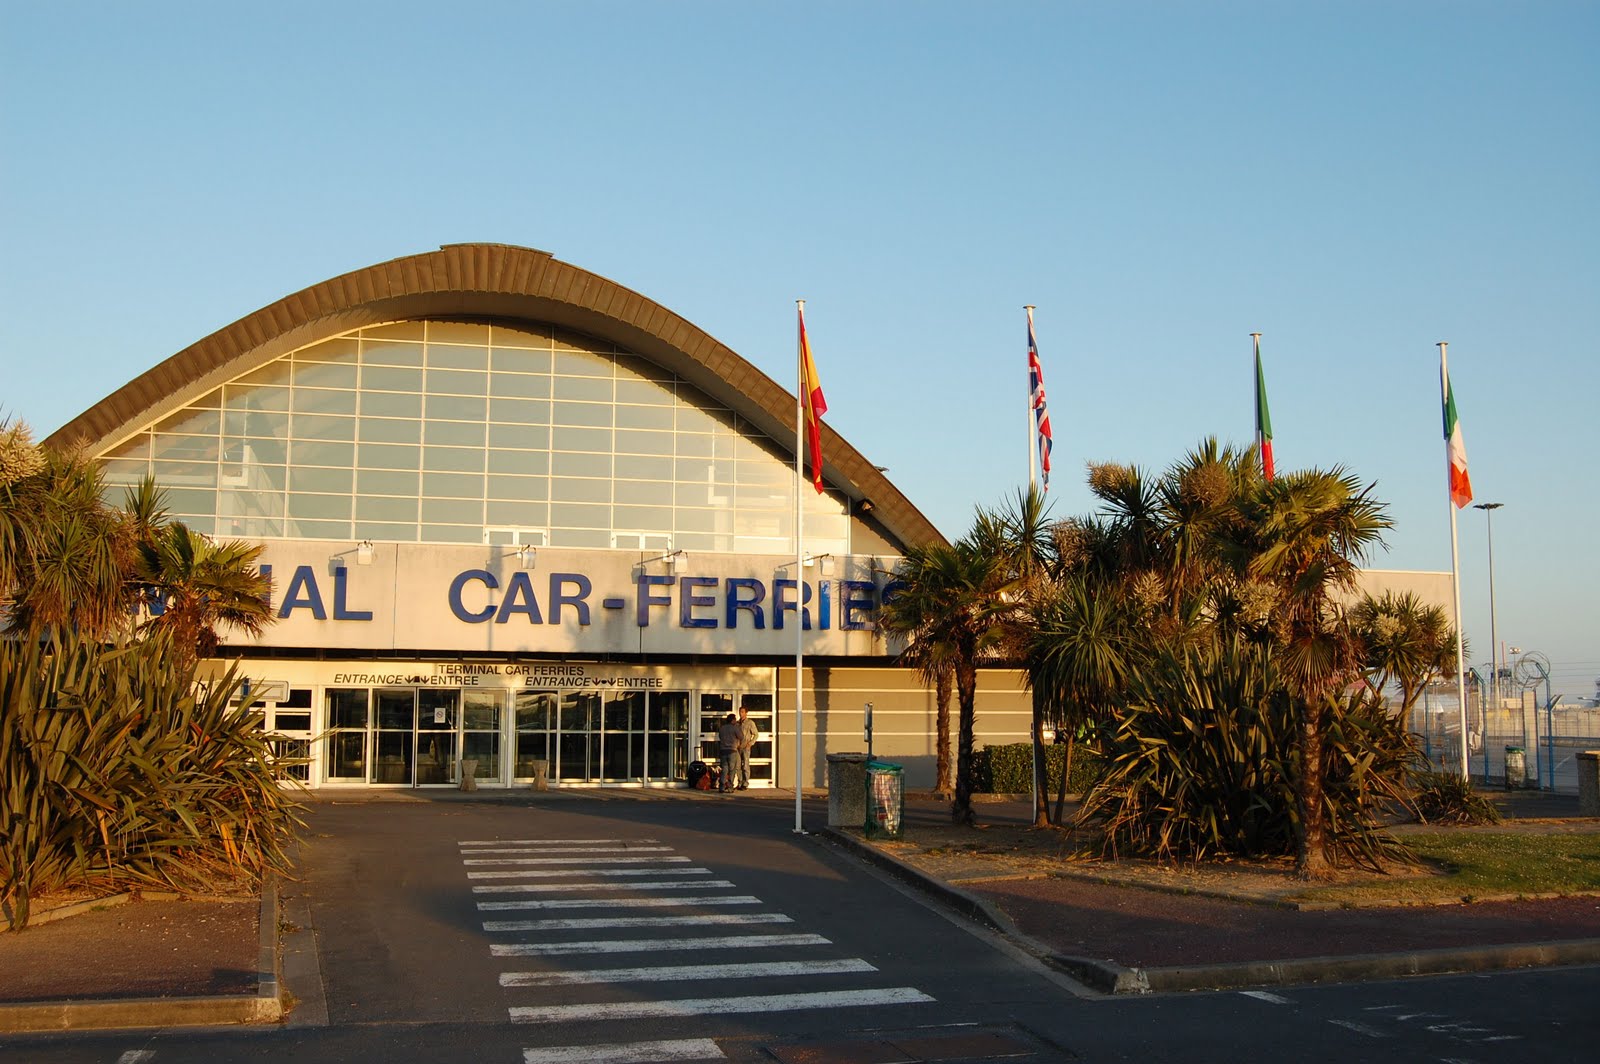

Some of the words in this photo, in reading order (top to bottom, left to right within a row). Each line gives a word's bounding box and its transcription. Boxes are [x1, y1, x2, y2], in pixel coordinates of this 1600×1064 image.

[438, 664, 501, 675] TERMINAL
[505, 665, 530, 676] CAR
[533, 665, 585, 677] FERRIES
[334, 673, 403, 685] ENTRANCE
[430, 675, 479, 686] ENTREE
[525, 676, 592, 687] ENTRANCE
[616, 677, 663, 688] ENTREE
